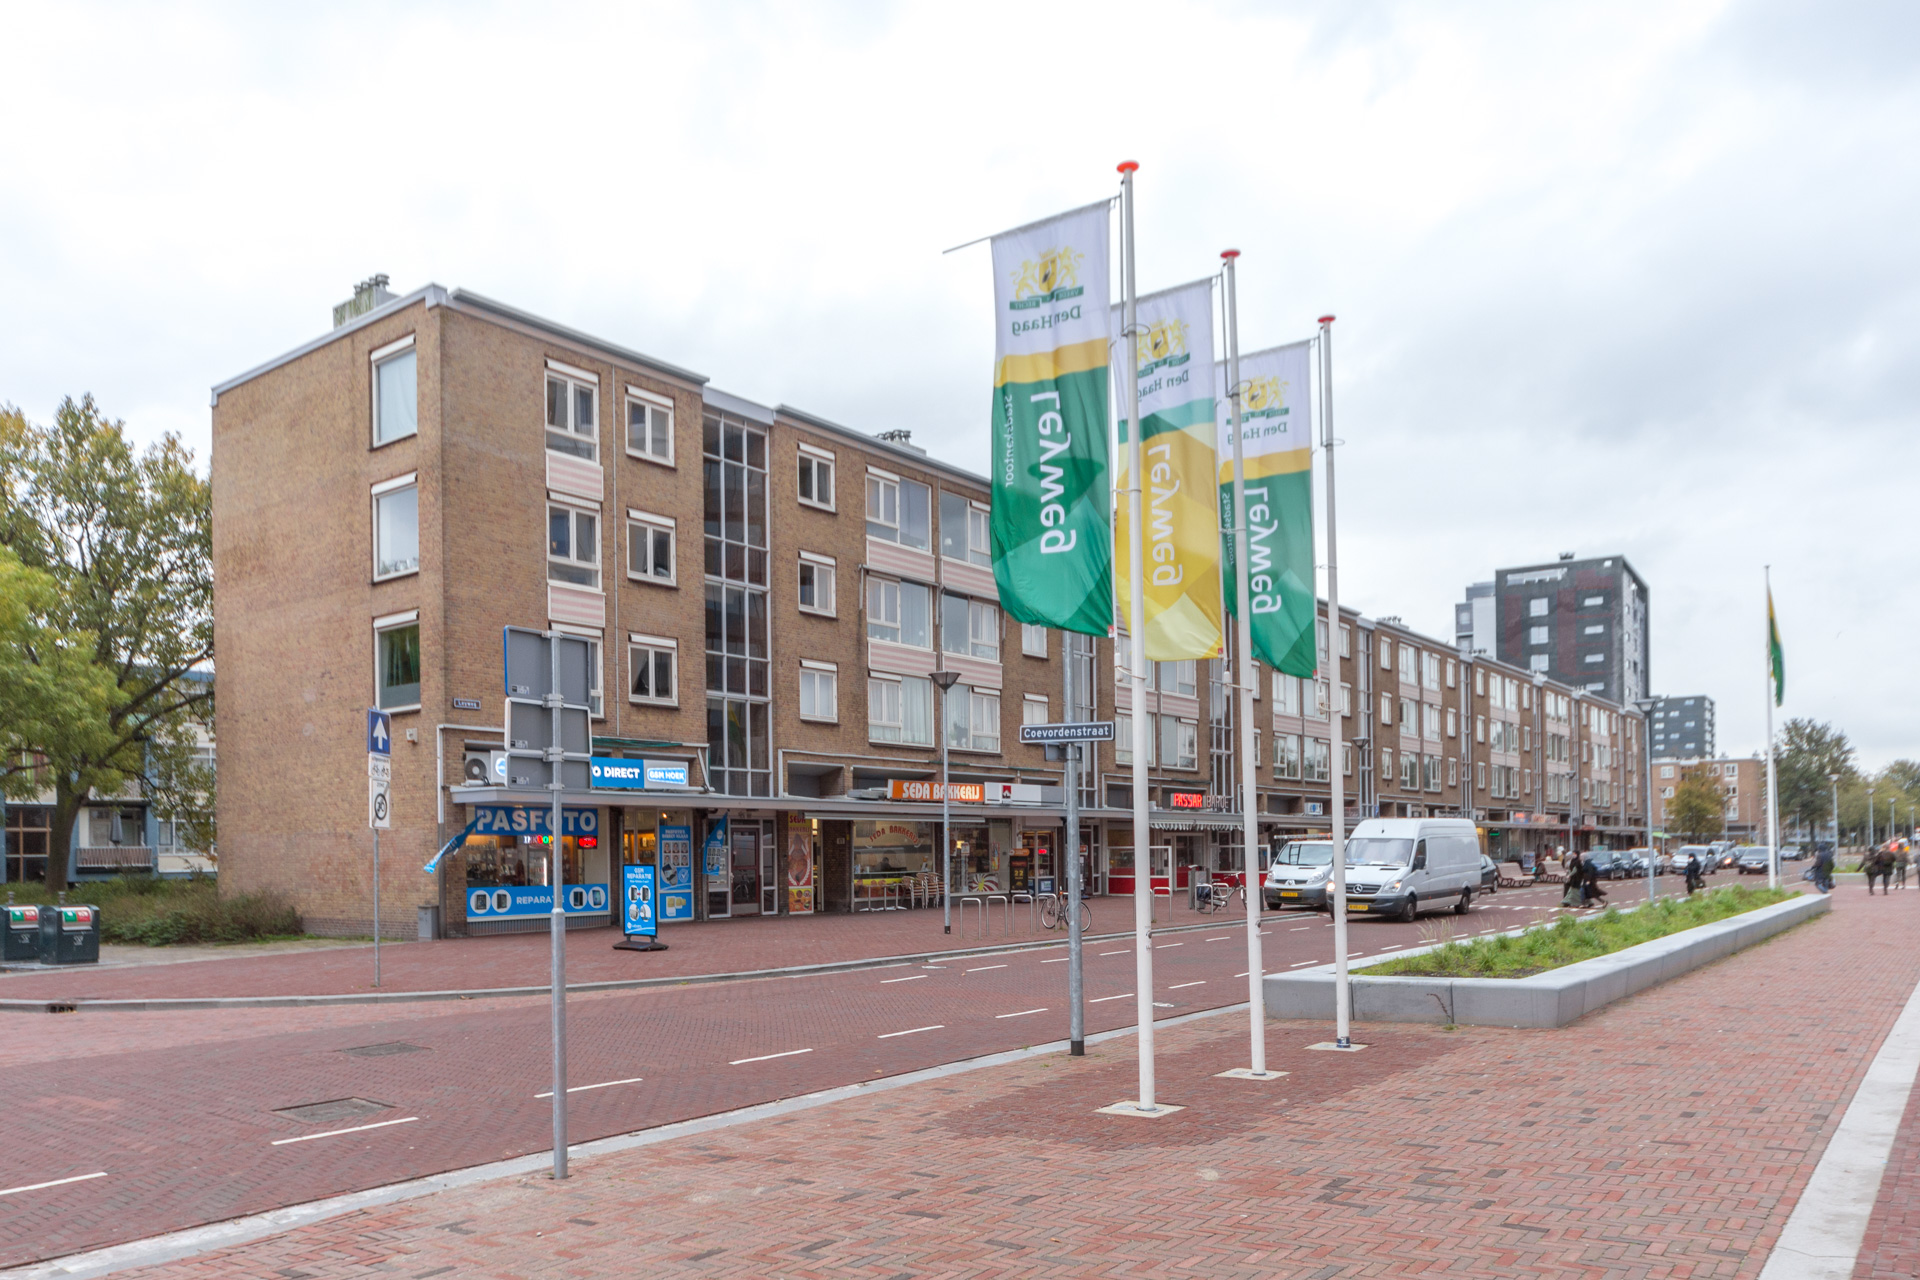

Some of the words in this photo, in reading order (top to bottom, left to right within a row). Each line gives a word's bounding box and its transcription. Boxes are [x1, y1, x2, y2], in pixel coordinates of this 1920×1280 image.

[1023, 725, 1109, 738] Coevordenstraat
[603, 766, 640, 779] DIRECT
[649, 770, 664, 779] GSM
[665, 771, 685, 781] HOEK
[902, 782, 930, 799] SEDA
[933, 783, 980, 800] BAKKERIJ
[1173, 792, 1203, 808] PASSAR
[516, 896, 564, 905] REPARA
